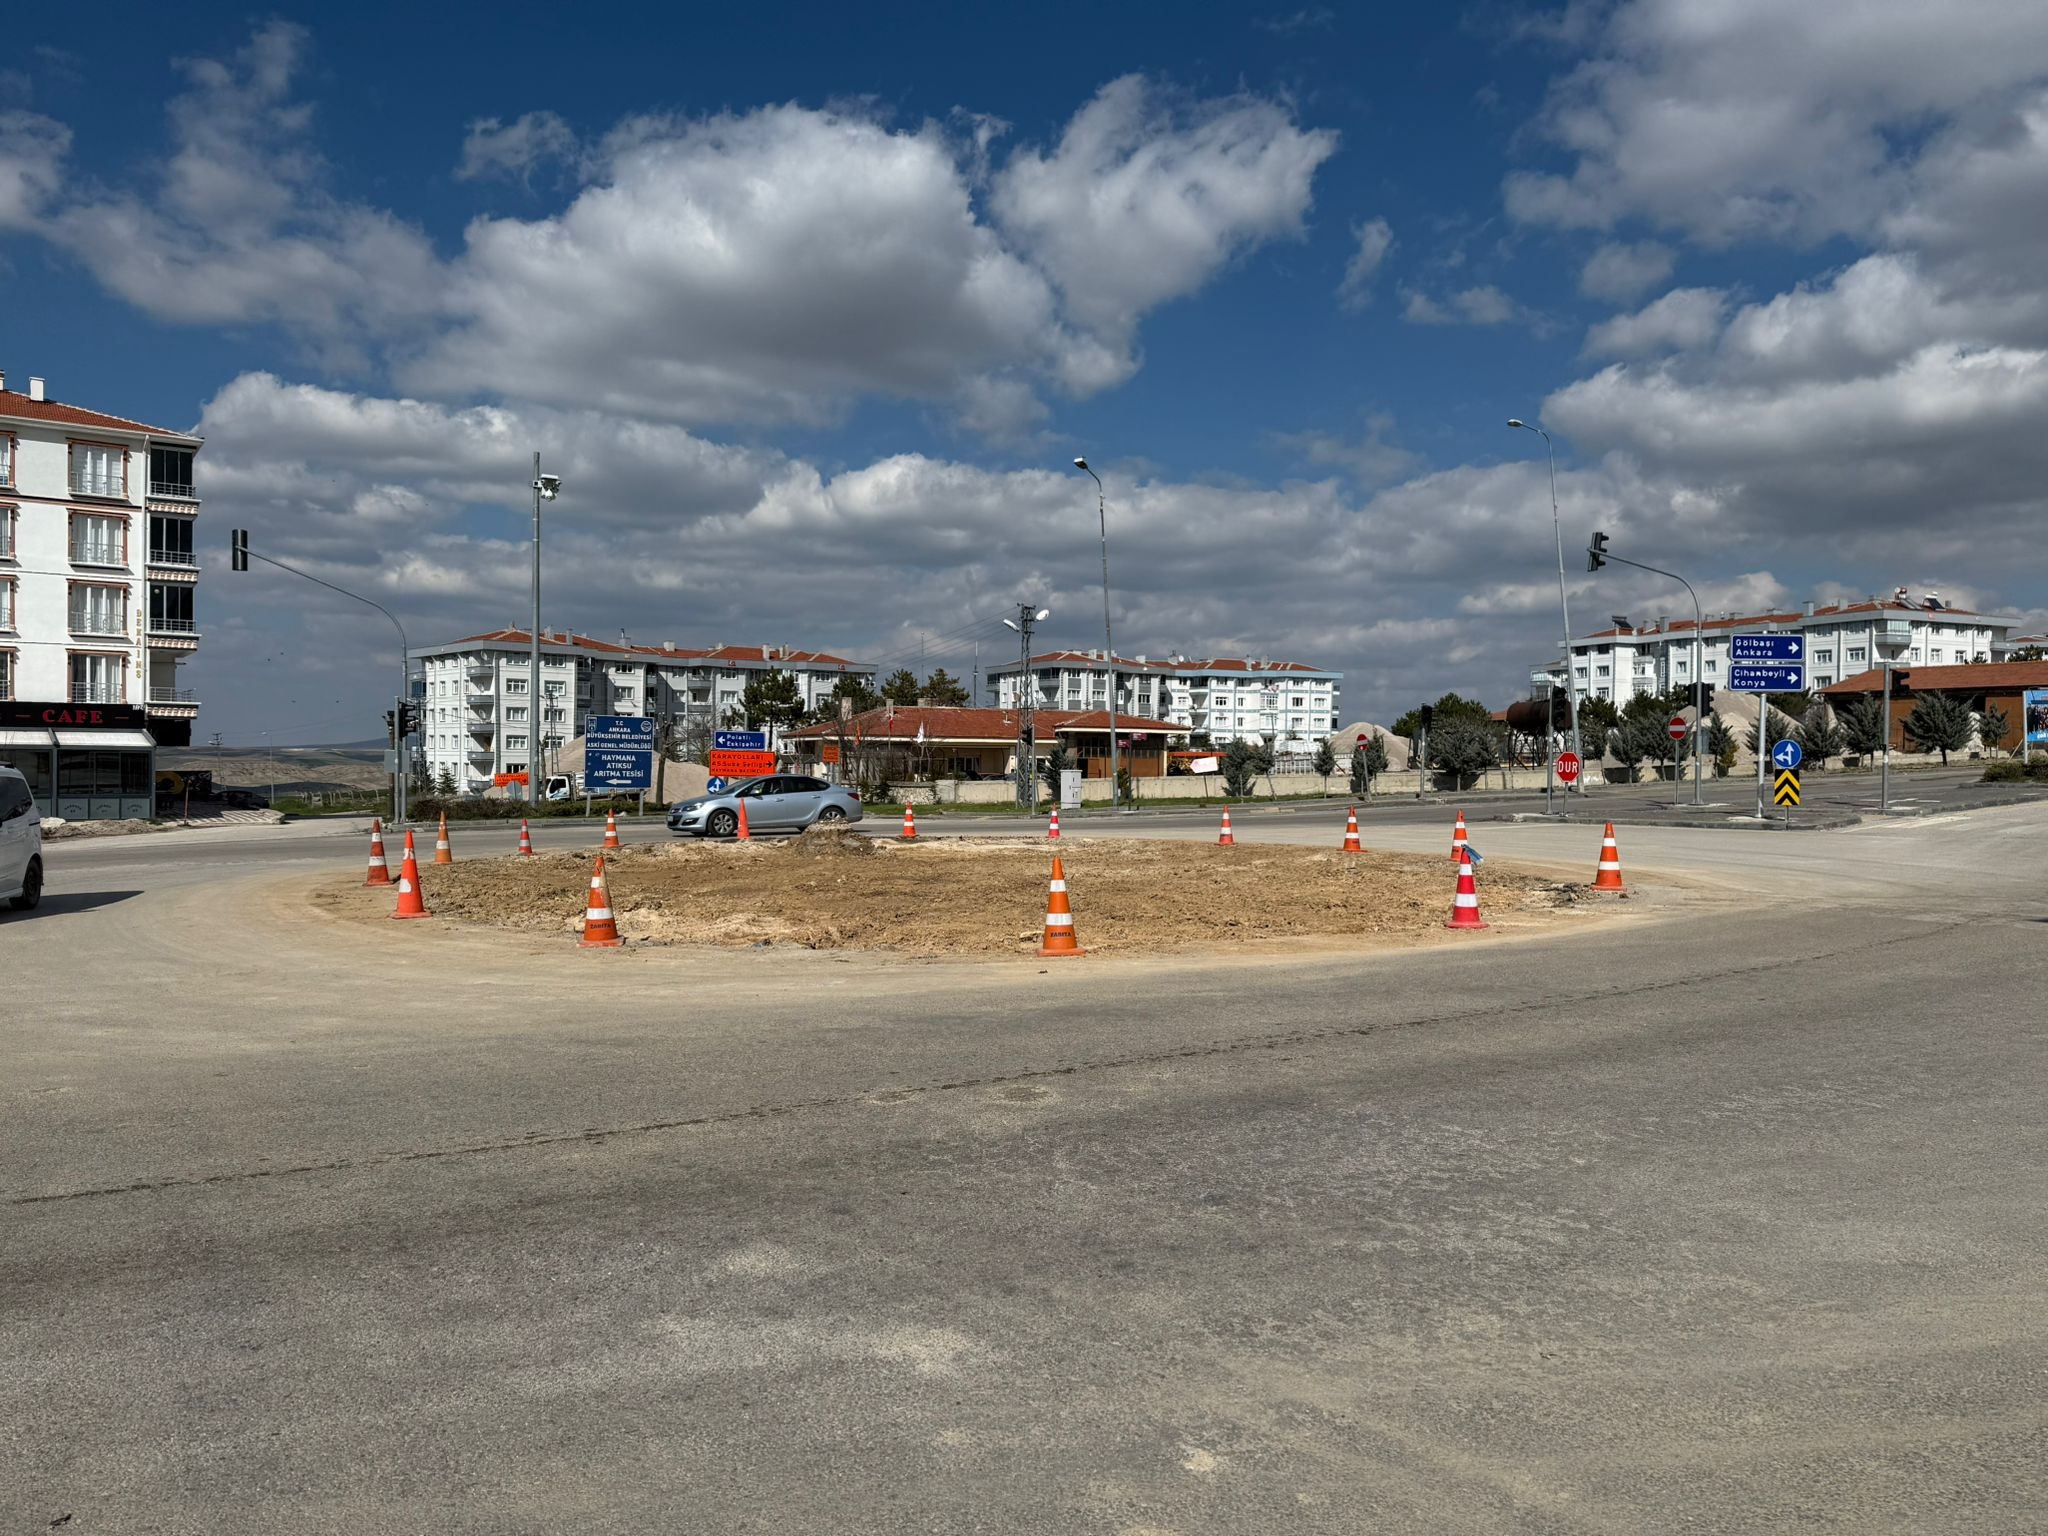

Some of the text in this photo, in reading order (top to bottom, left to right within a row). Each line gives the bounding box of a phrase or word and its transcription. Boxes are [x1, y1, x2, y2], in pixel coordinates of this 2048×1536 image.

[1735, 638, 1774, 647] Gölbaşı
[1735, 648, 1773, 656] Ankara
[1734, 669, 1785, 678] Cihanbeyli
[1734, 679, 1766, 688] Konya
[42, 709, 103, 724] CAFE
[711, 753, 764, 761] KARAYOLLARI
[1558, 761, 1578, 773] DUR
[621, 769, 644, 777] TESİSİ
